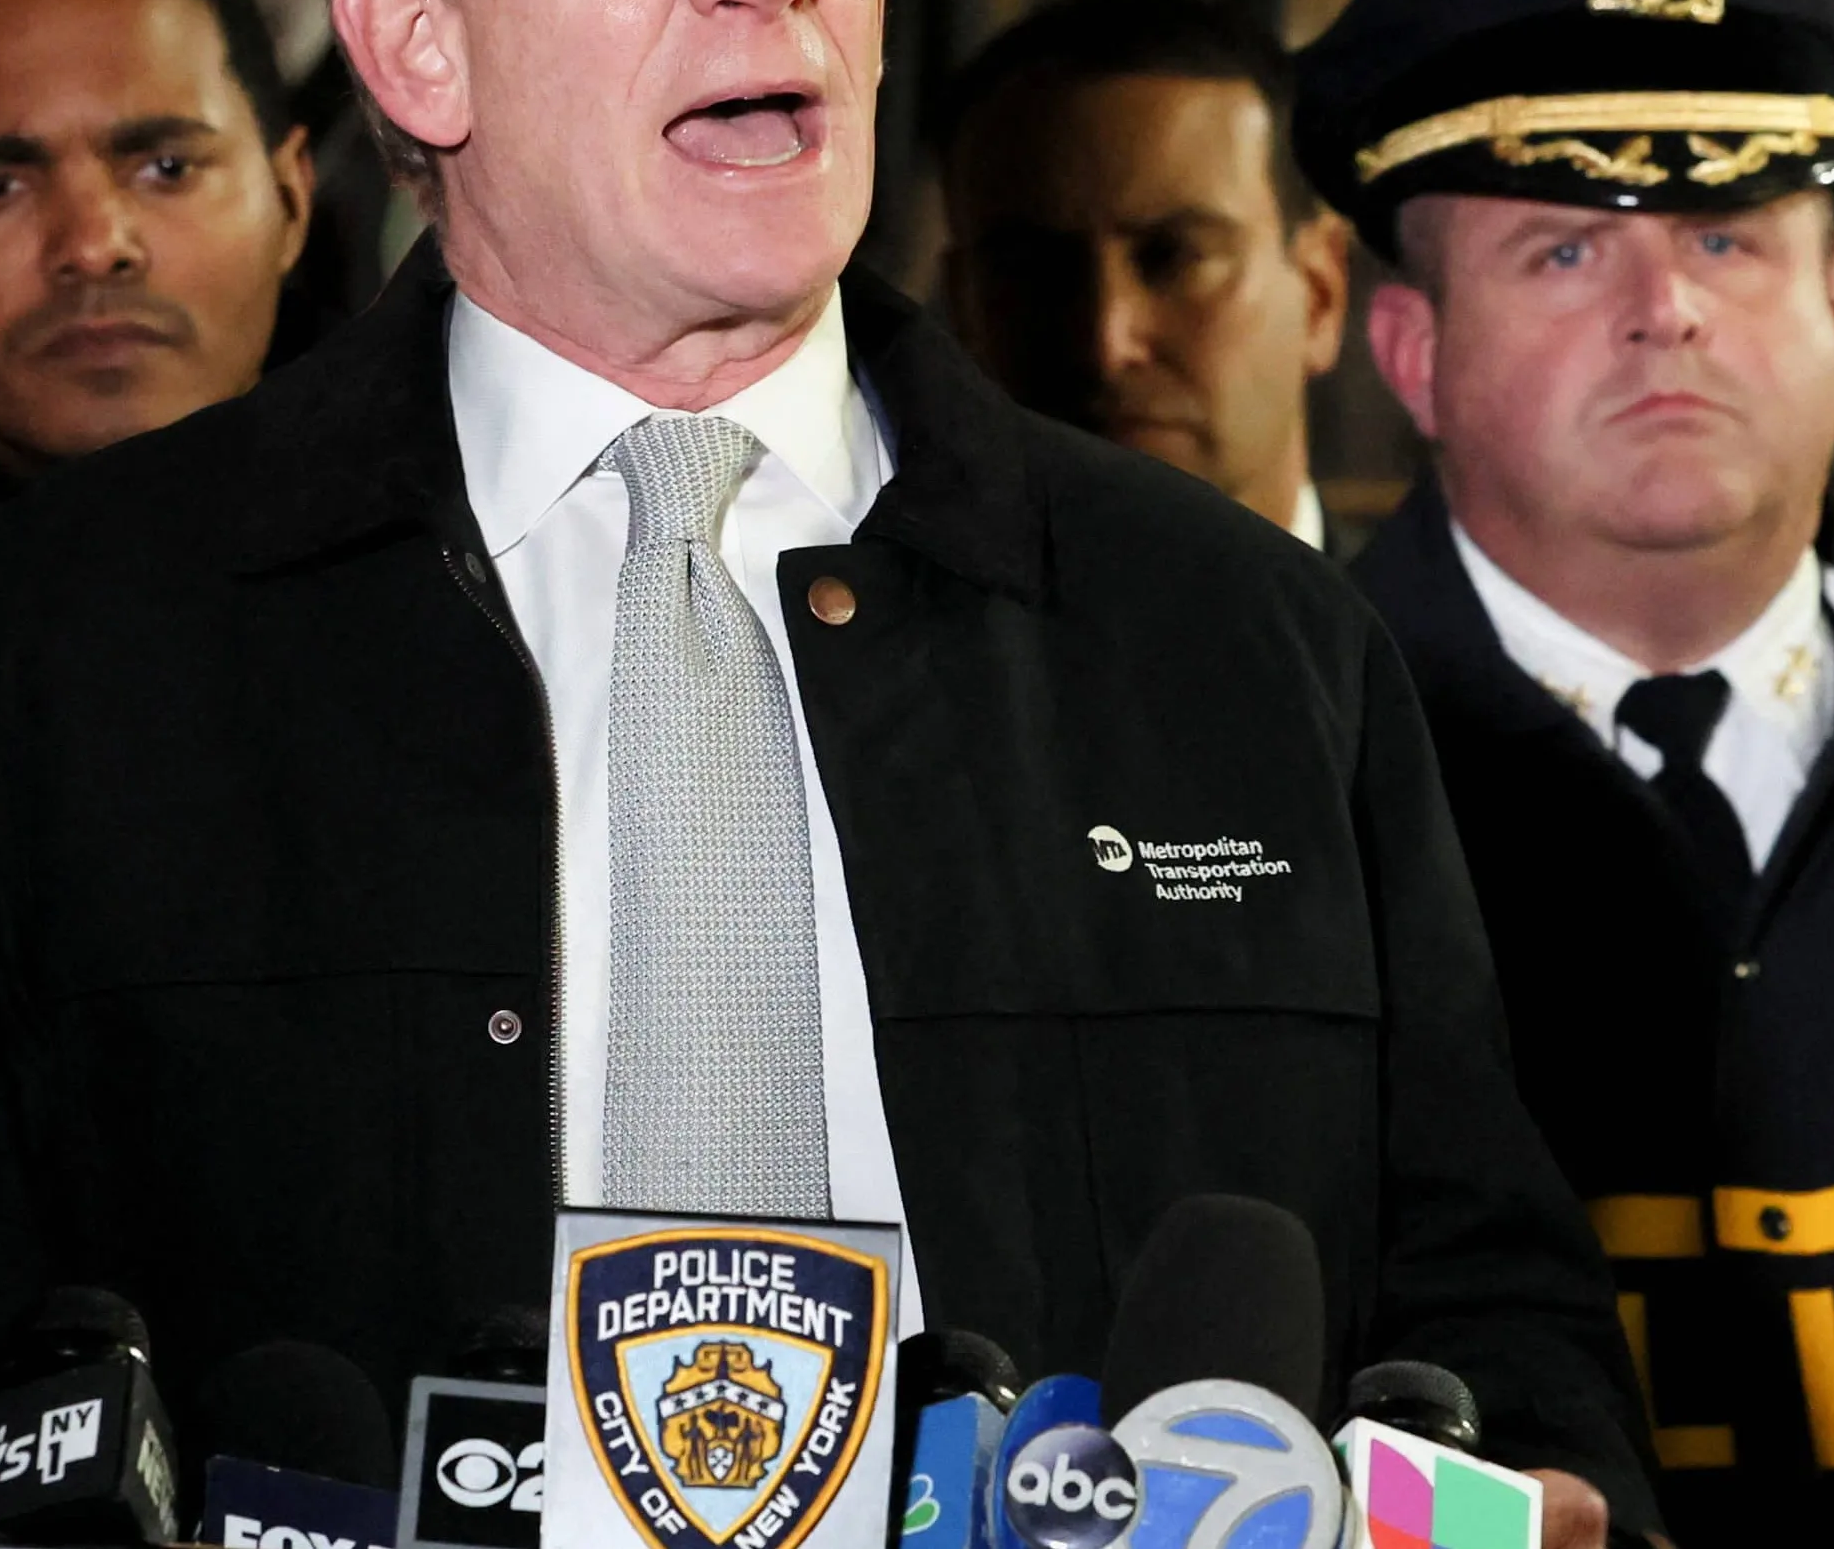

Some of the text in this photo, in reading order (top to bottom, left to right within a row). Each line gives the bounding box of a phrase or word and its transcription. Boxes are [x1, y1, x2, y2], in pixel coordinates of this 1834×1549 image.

[1137, 836, 1264, 861] Metropolitan
[1144, 855, 1292, 882] Transportation
[1155, 880, 1243, 903] Authority
[653, 1249, 796, 1292] POLICE
[597, 1285, 853, 1348] DEPARTMENT
[50, 1404, 95, 1436] NY
[593, 1390, 688, 1537] CITY OF
[732, 1377, 857, 1549] NEW YORK
[1007, 1453, 1138, 1522] abc
